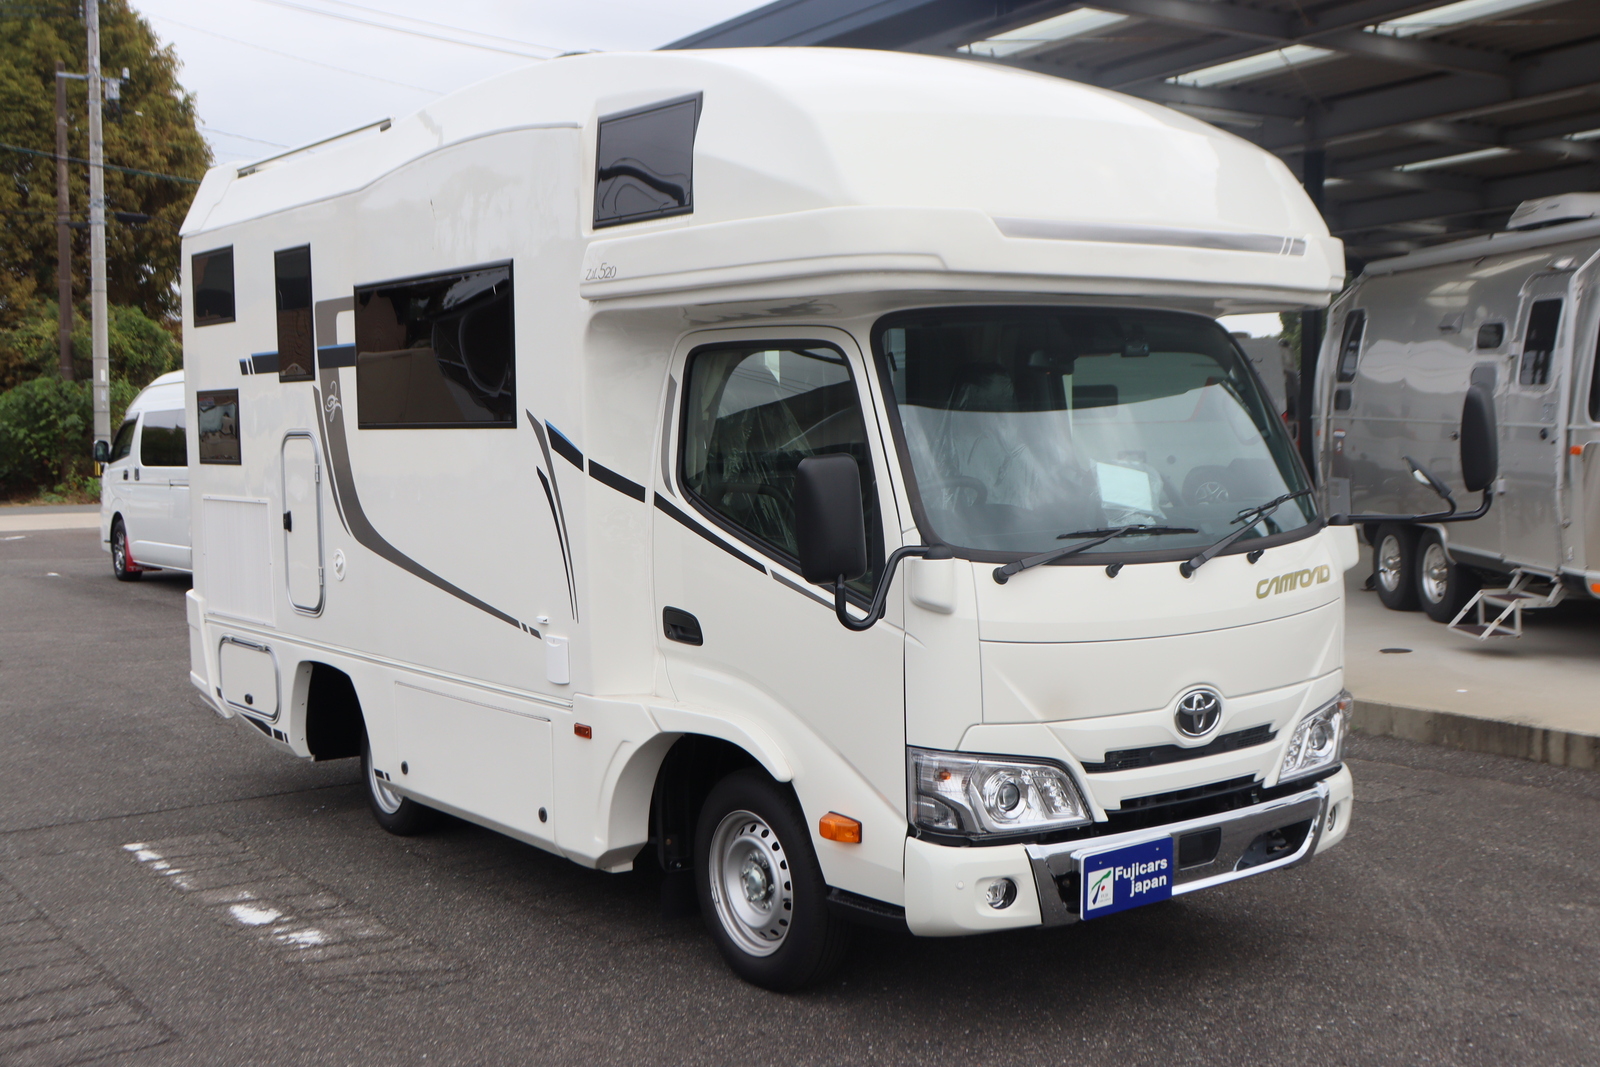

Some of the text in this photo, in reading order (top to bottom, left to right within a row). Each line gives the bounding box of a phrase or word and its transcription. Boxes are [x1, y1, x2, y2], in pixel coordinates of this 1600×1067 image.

[597, 262, 617, 280] 520
[1114, 858, 1168, 881] Fujicars
[1129, 875, 1167, 898] japan
